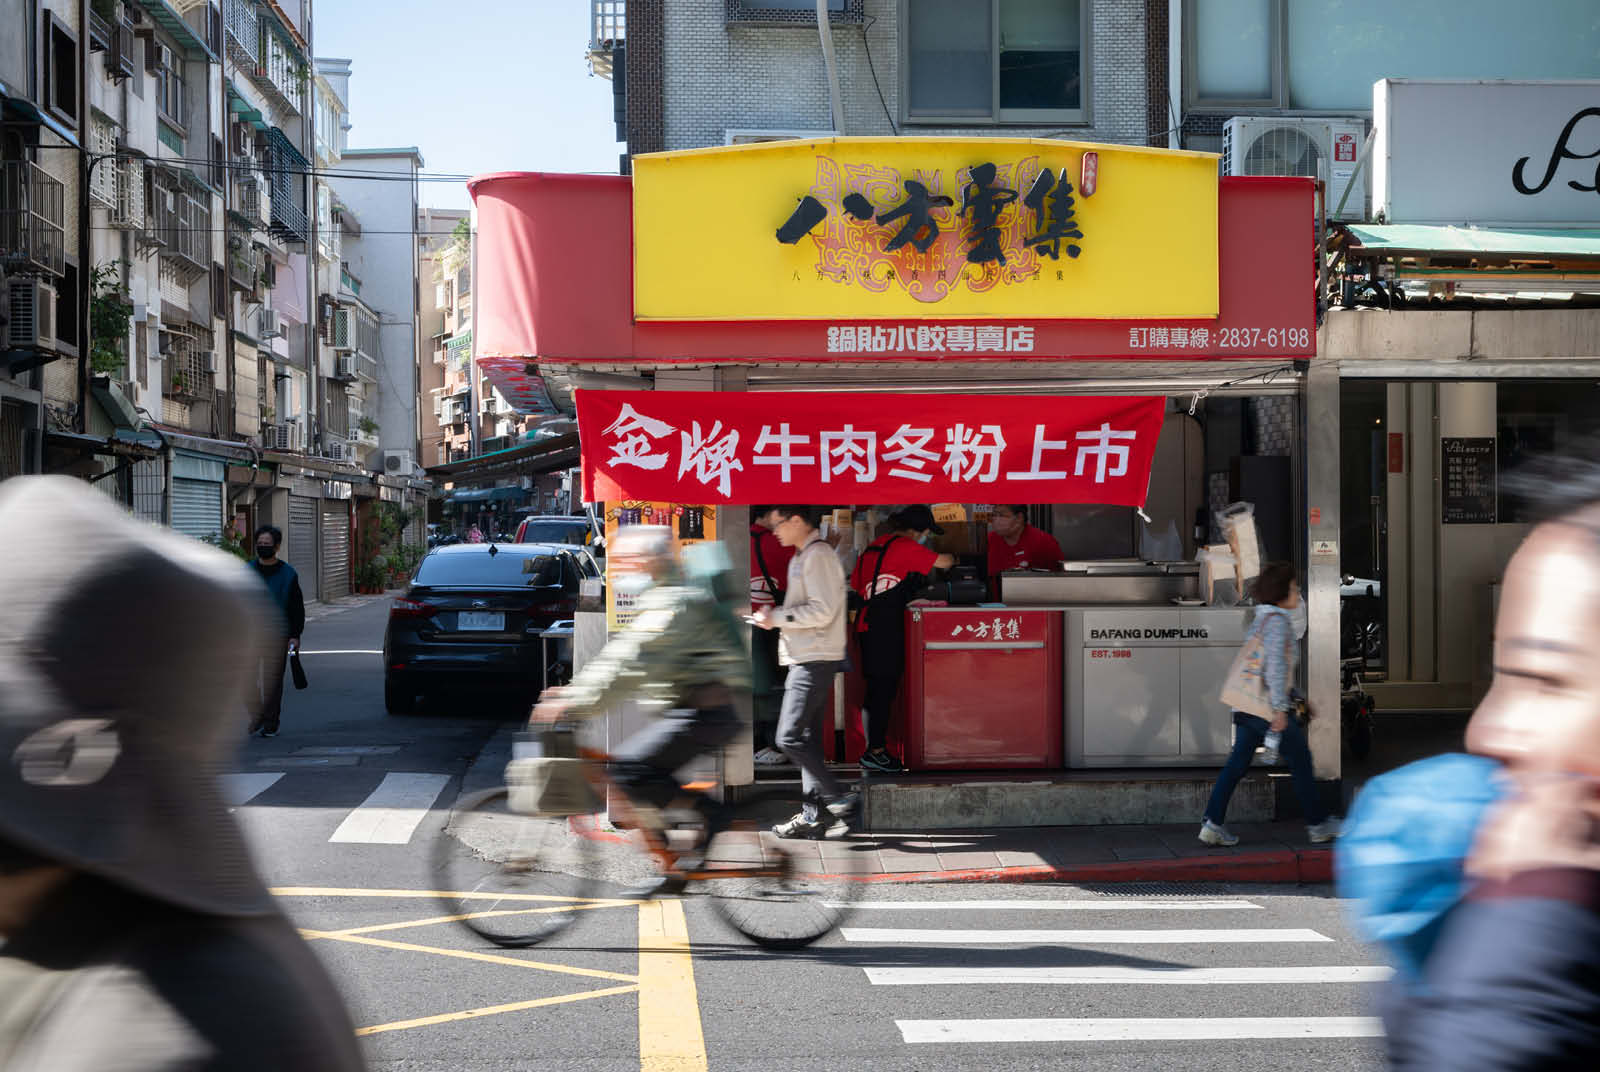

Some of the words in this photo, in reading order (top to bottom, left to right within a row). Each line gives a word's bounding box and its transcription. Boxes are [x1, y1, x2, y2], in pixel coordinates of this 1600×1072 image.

[776, 162, 1085, 267] 八方雲集
[826, 325, 1035, 353] 鍋貼水餃專賣店
[601, 402, 1137, 498] 金牌牛肉冬粉上市
[951, 617, 1020, 641] 八方雲集
[1091, 629, 1141, 639] BAFANG
[1144, 629, 1208, 639] DUMPLING
